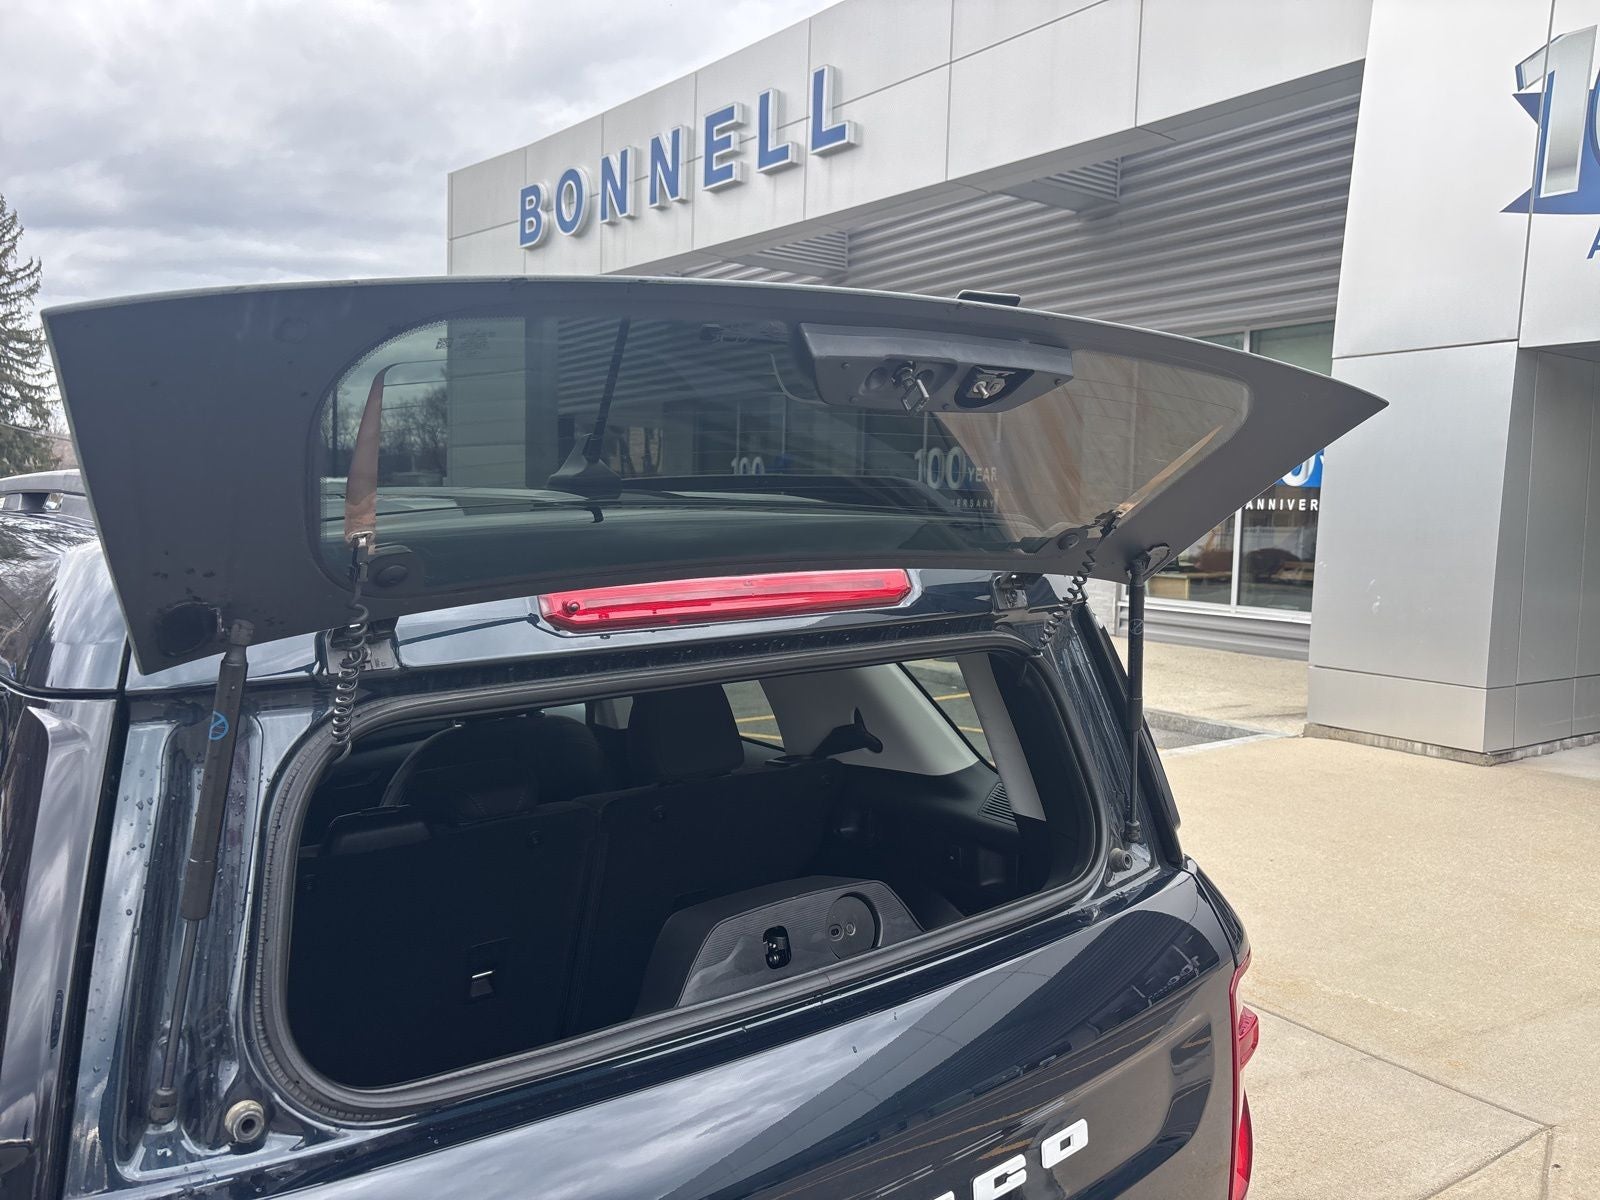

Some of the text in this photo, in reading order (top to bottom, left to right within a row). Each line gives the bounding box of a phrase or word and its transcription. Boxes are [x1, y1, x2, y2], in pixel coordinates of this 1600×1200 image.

[1515, 25, 1600, 198] 1
[519, 64, 859, 248] BONNELL
[731, 456, 765, 475] 100
[914, 446, 998, 490] 100 YEAR
[951, 498, 994, 508] ERSARY
[1245, 498, 1318, 511] ANNIVER
[934, 1118, 1088, 1200] CO
